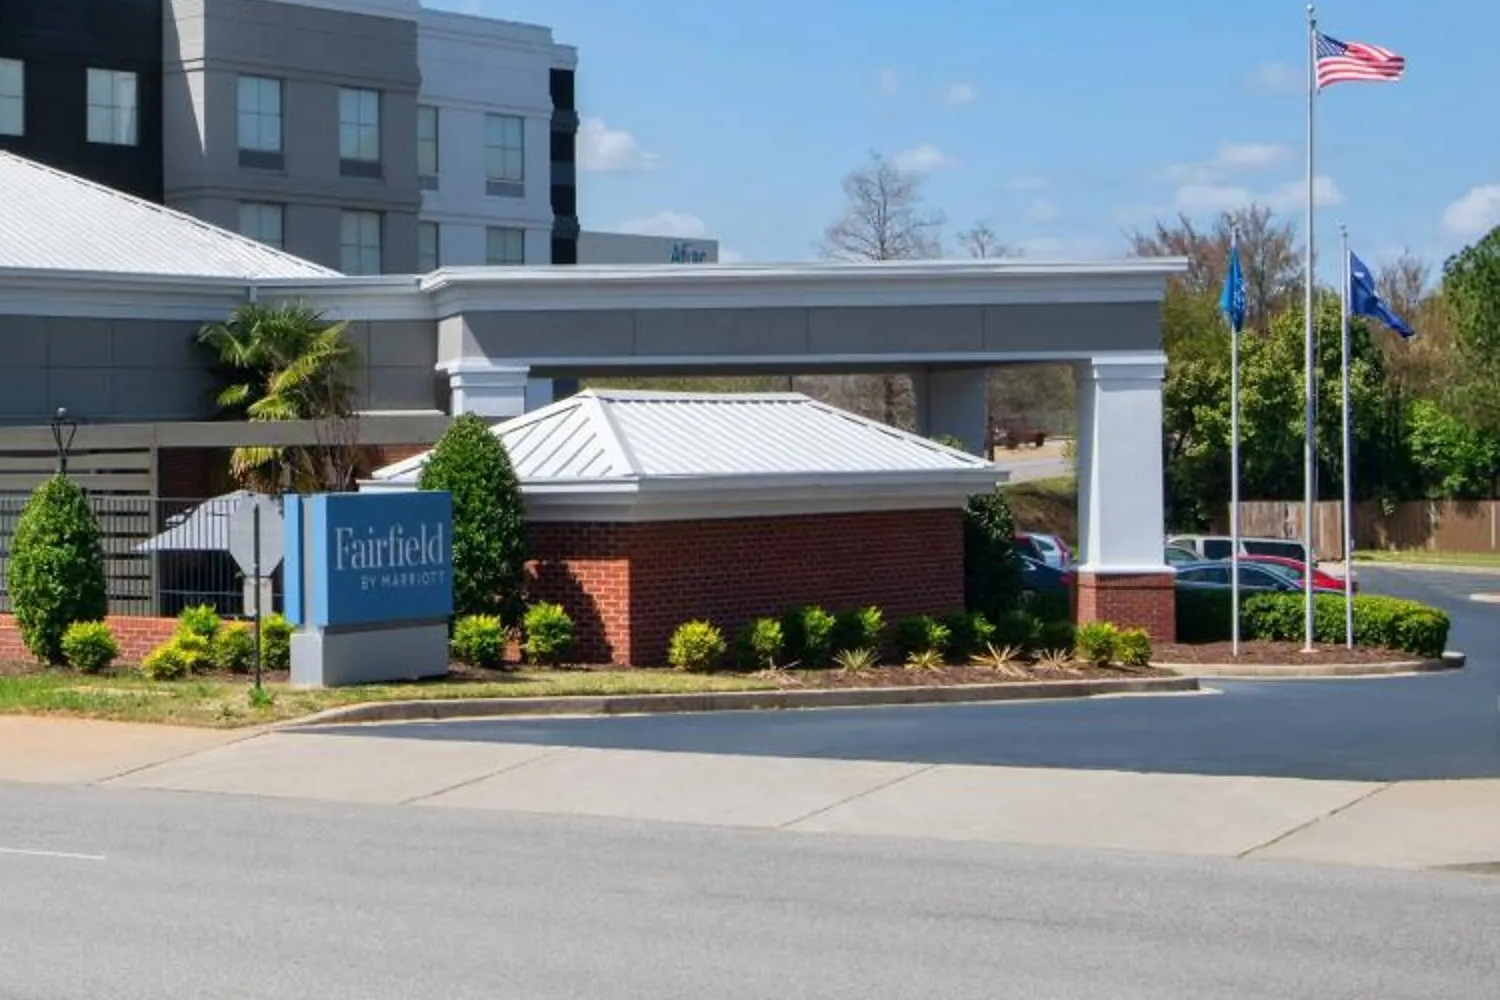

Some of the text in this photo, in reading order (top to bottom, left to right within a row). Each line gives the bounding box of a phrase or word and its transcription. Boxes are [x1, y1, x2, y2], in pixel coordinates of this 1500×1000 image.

[336, 522, 444, 570] Fairfield
[361, 572, 445, 590] BY MARRIOTT
